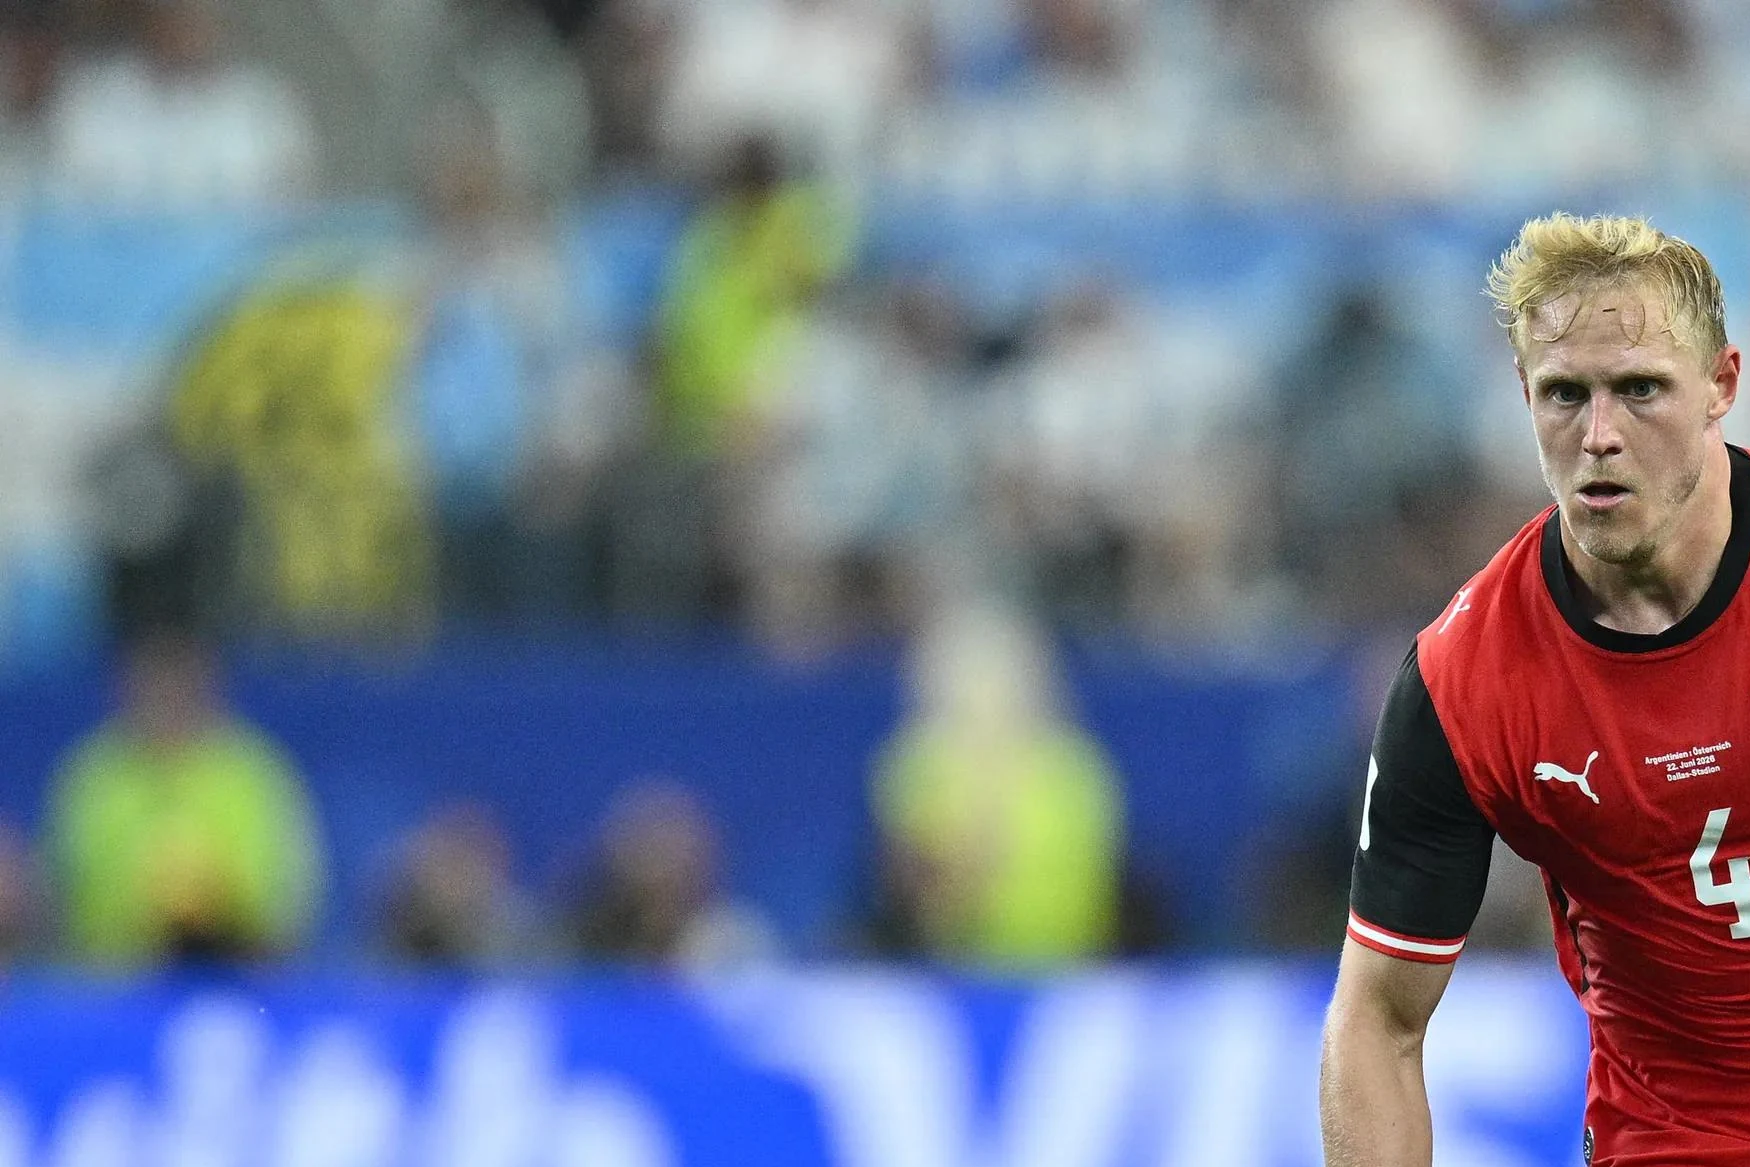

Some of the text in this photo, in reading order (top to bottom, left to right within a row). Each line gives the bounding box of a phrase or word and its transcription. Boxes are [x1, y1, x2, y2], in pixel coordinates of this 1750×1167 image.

[1645, 751, 1688, 765] Argentinien
[1692, 741, 1731, 756] Österreich
[1666, 763, 1678, 771] 22.
[1680, 759, 1695, 769] Juni
[1667, 765, 1720, 782] Dallas-Stadion
